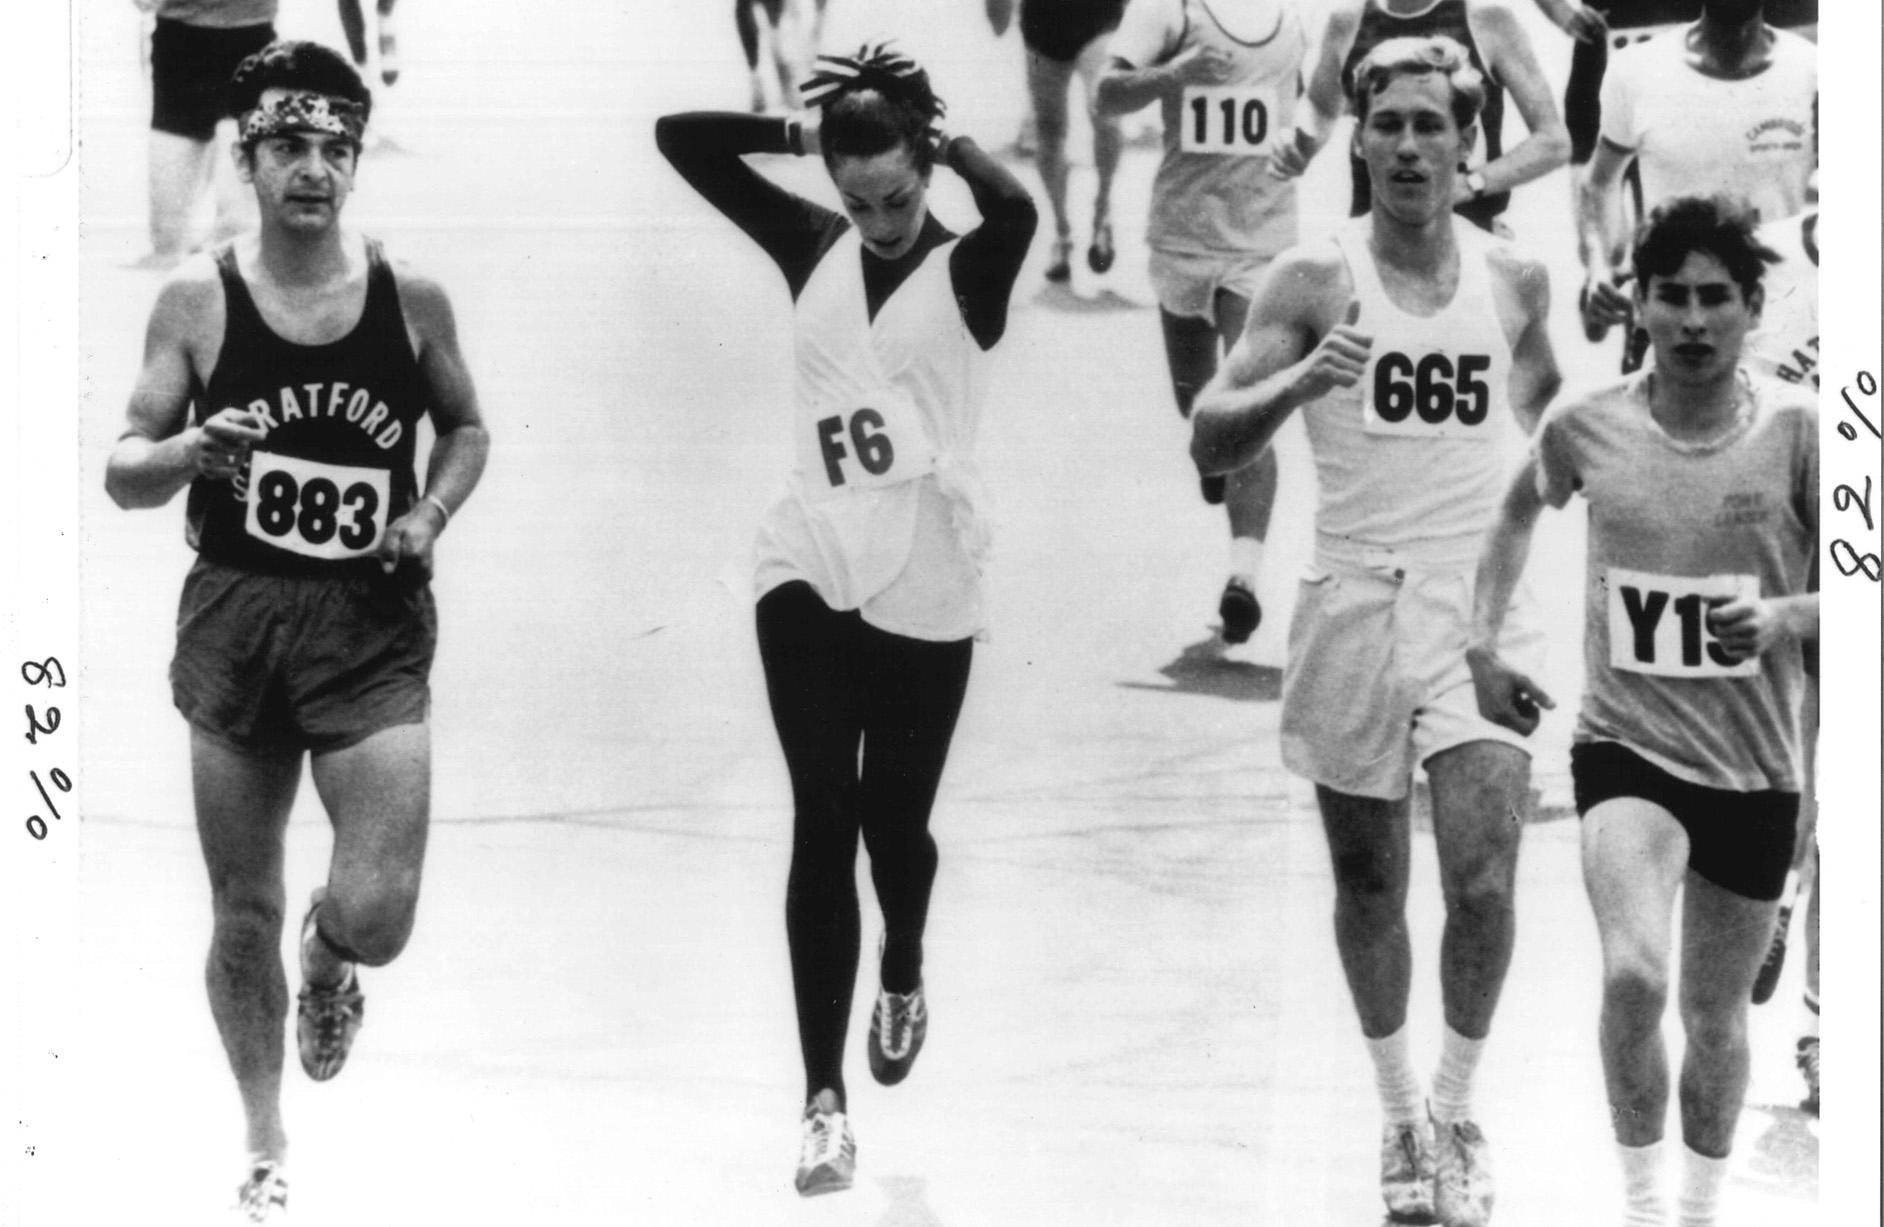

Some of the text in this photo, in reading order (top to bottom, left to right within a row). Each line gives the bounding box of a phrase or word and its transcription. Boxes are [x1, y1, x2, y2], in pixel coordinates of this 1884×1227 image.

[1190, 96, 1267, 145] 110
[248, 382, 403, 449] RATFORD
[1373, 351, 1491, 426] 665
[817, 407, 895, 487] F6
[256, 469, 379, 550] 883
